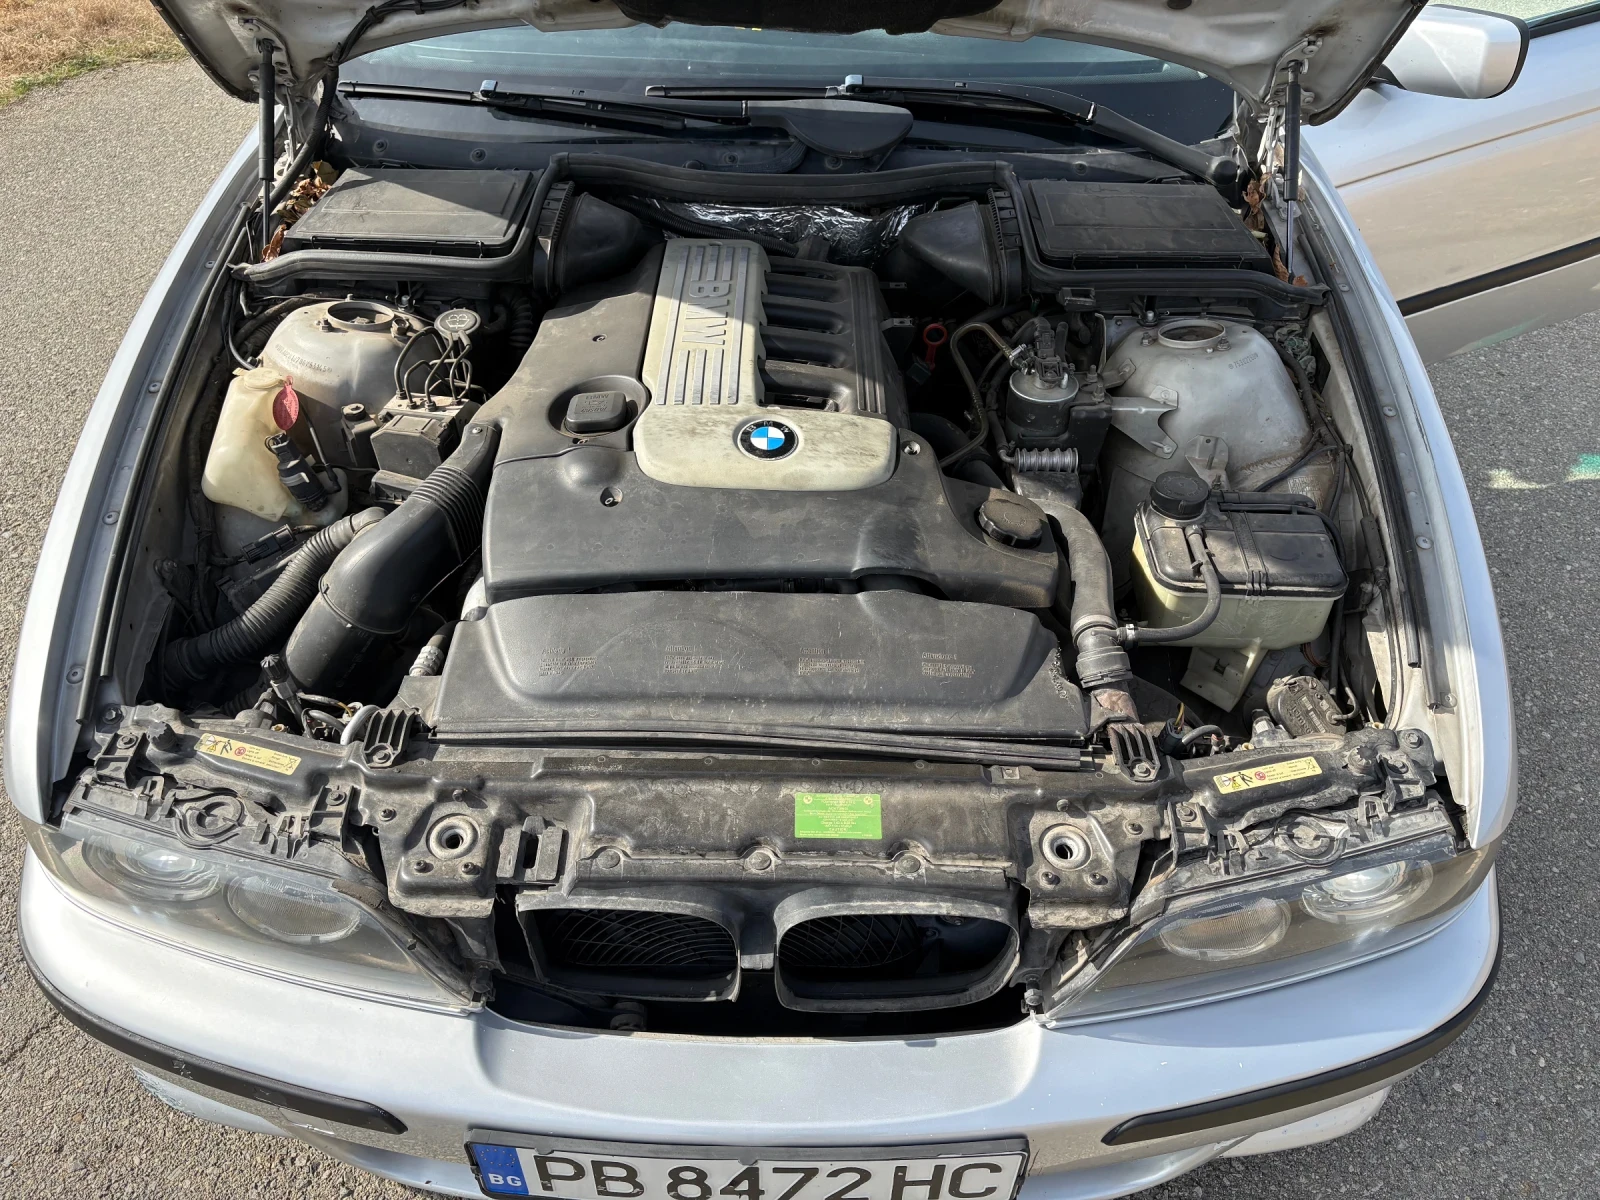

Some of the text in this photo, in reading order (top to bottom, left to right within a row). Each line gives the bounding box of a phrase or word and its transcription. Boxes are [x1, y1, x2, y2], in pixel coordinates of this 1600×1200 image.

[682, 280, 731, 345] BMW
[746, 420, 790, 433] BMW
[487, 1173, 522, 1187] BG
[533, 1154, 1003, 1200] PB 8472 HC
